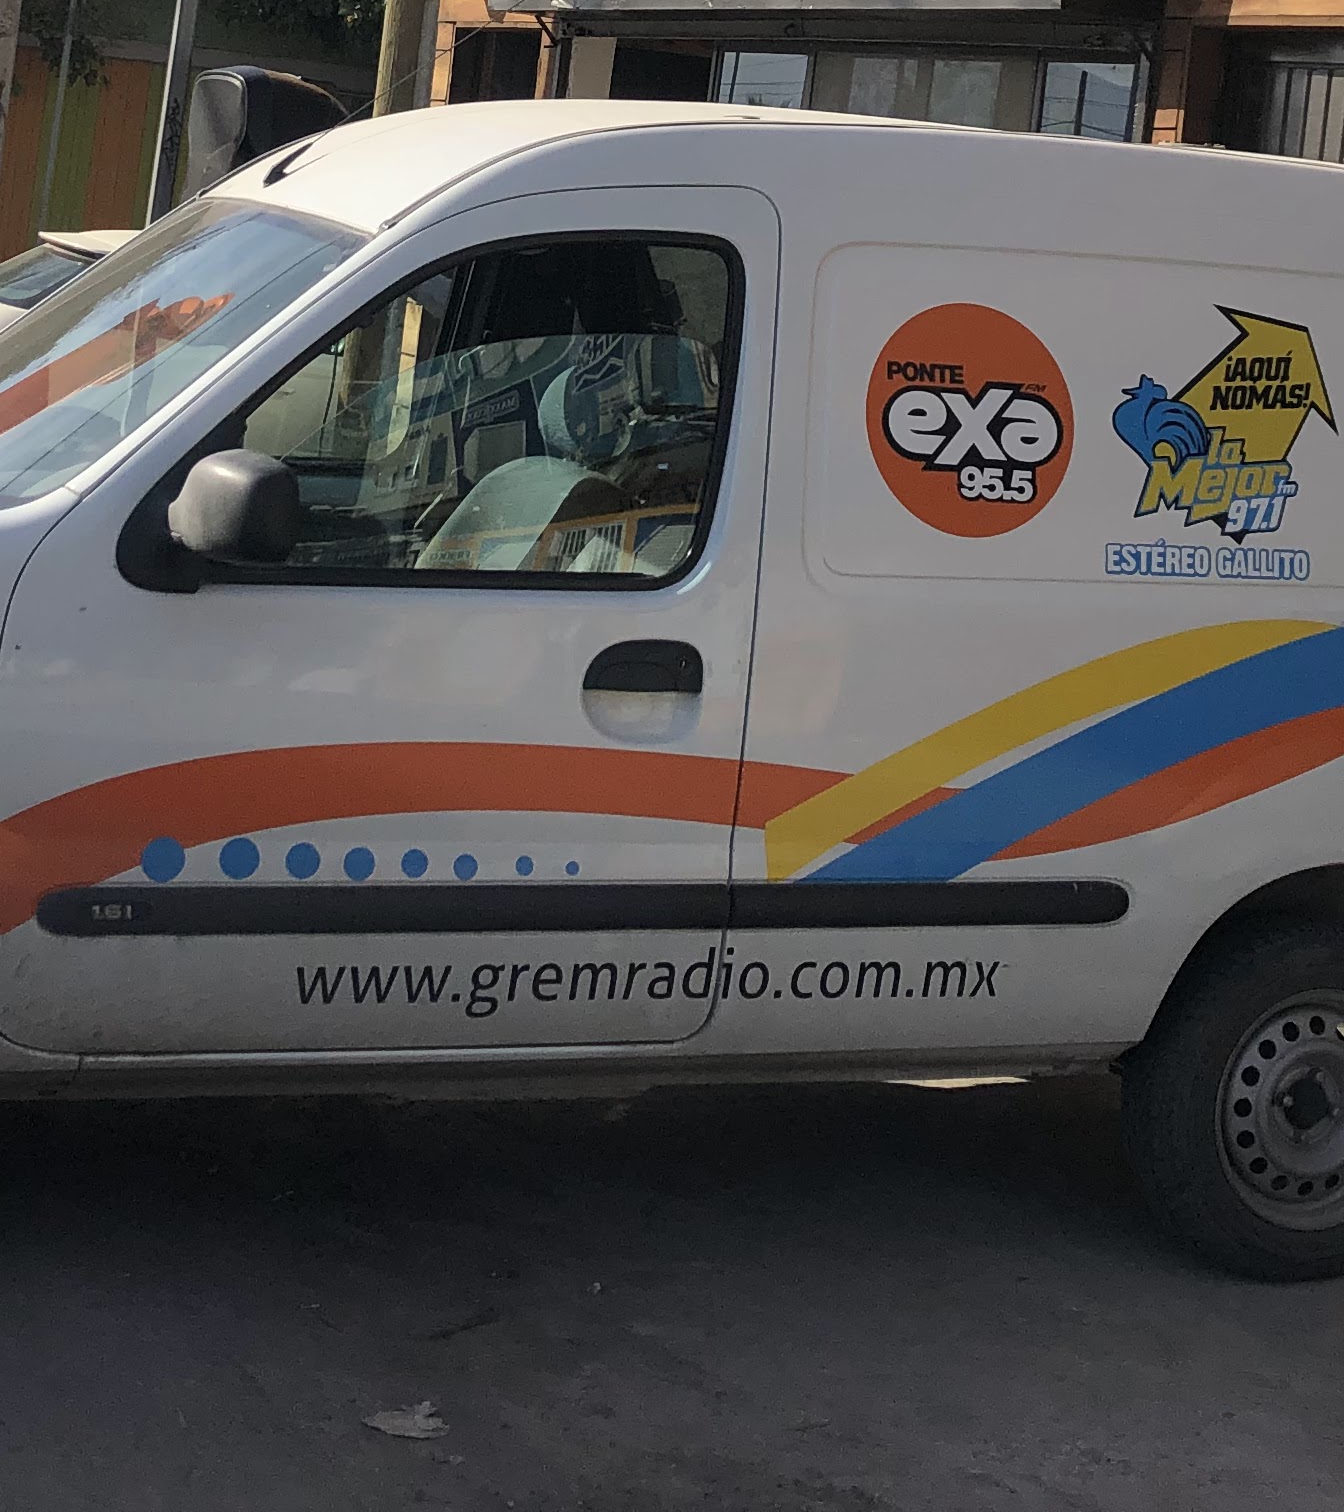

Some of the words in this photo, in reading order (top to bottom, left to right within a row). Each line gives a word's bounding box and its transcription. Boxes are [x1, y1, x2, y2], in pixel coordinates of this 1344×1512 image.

[887, 360, 965, 384] PONTE
[1223, 350, 1293, 383] ¡AQUÍ
[1210, 382, 1312, 411] NOMÁS!
[887, 388, 1059, 466] exa
[960, 465, 1034, 502] 95.5
[1138, 456, 1292, 520] Mejor
[1224, 496, 1283, 534] 97.1
[1106, 539, 1211, 576] ESTÉREO
[1216, 548, 1309, 580] GALLITO
[296, 946, 1001, 1018] www.gremradio.com.mx
